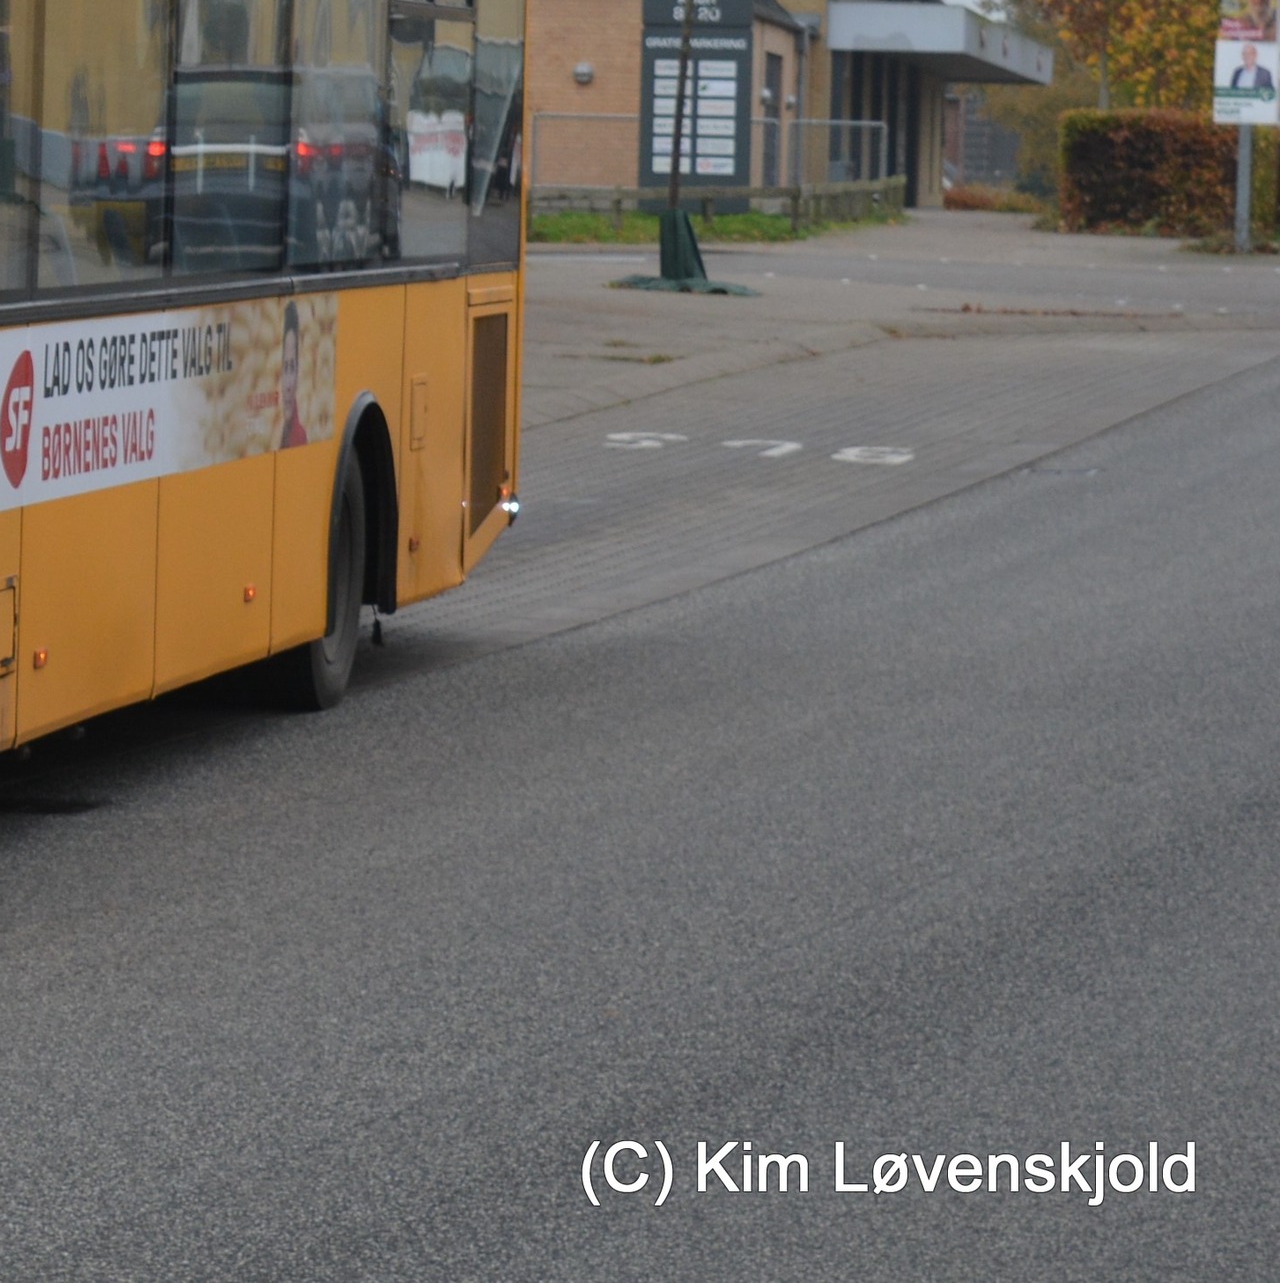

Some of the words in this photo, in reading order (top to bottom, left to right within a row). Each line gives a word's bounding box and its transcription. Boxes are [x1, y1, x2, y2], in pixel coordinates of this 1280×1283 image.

[43, 338, 72, 399] LAD
[75, 337, 95, 394] OS
[98, 332, 136, 391] GØRE
[139, 327, 179, 385] DETTE
[181, 324, 214, 379] VALG
[216, 321, 234, 374] TIL
[4, 385, 32, 453] SF
[41, 412, 118, 482] BØRNENES
[121, 407, 155, 465] VALG
